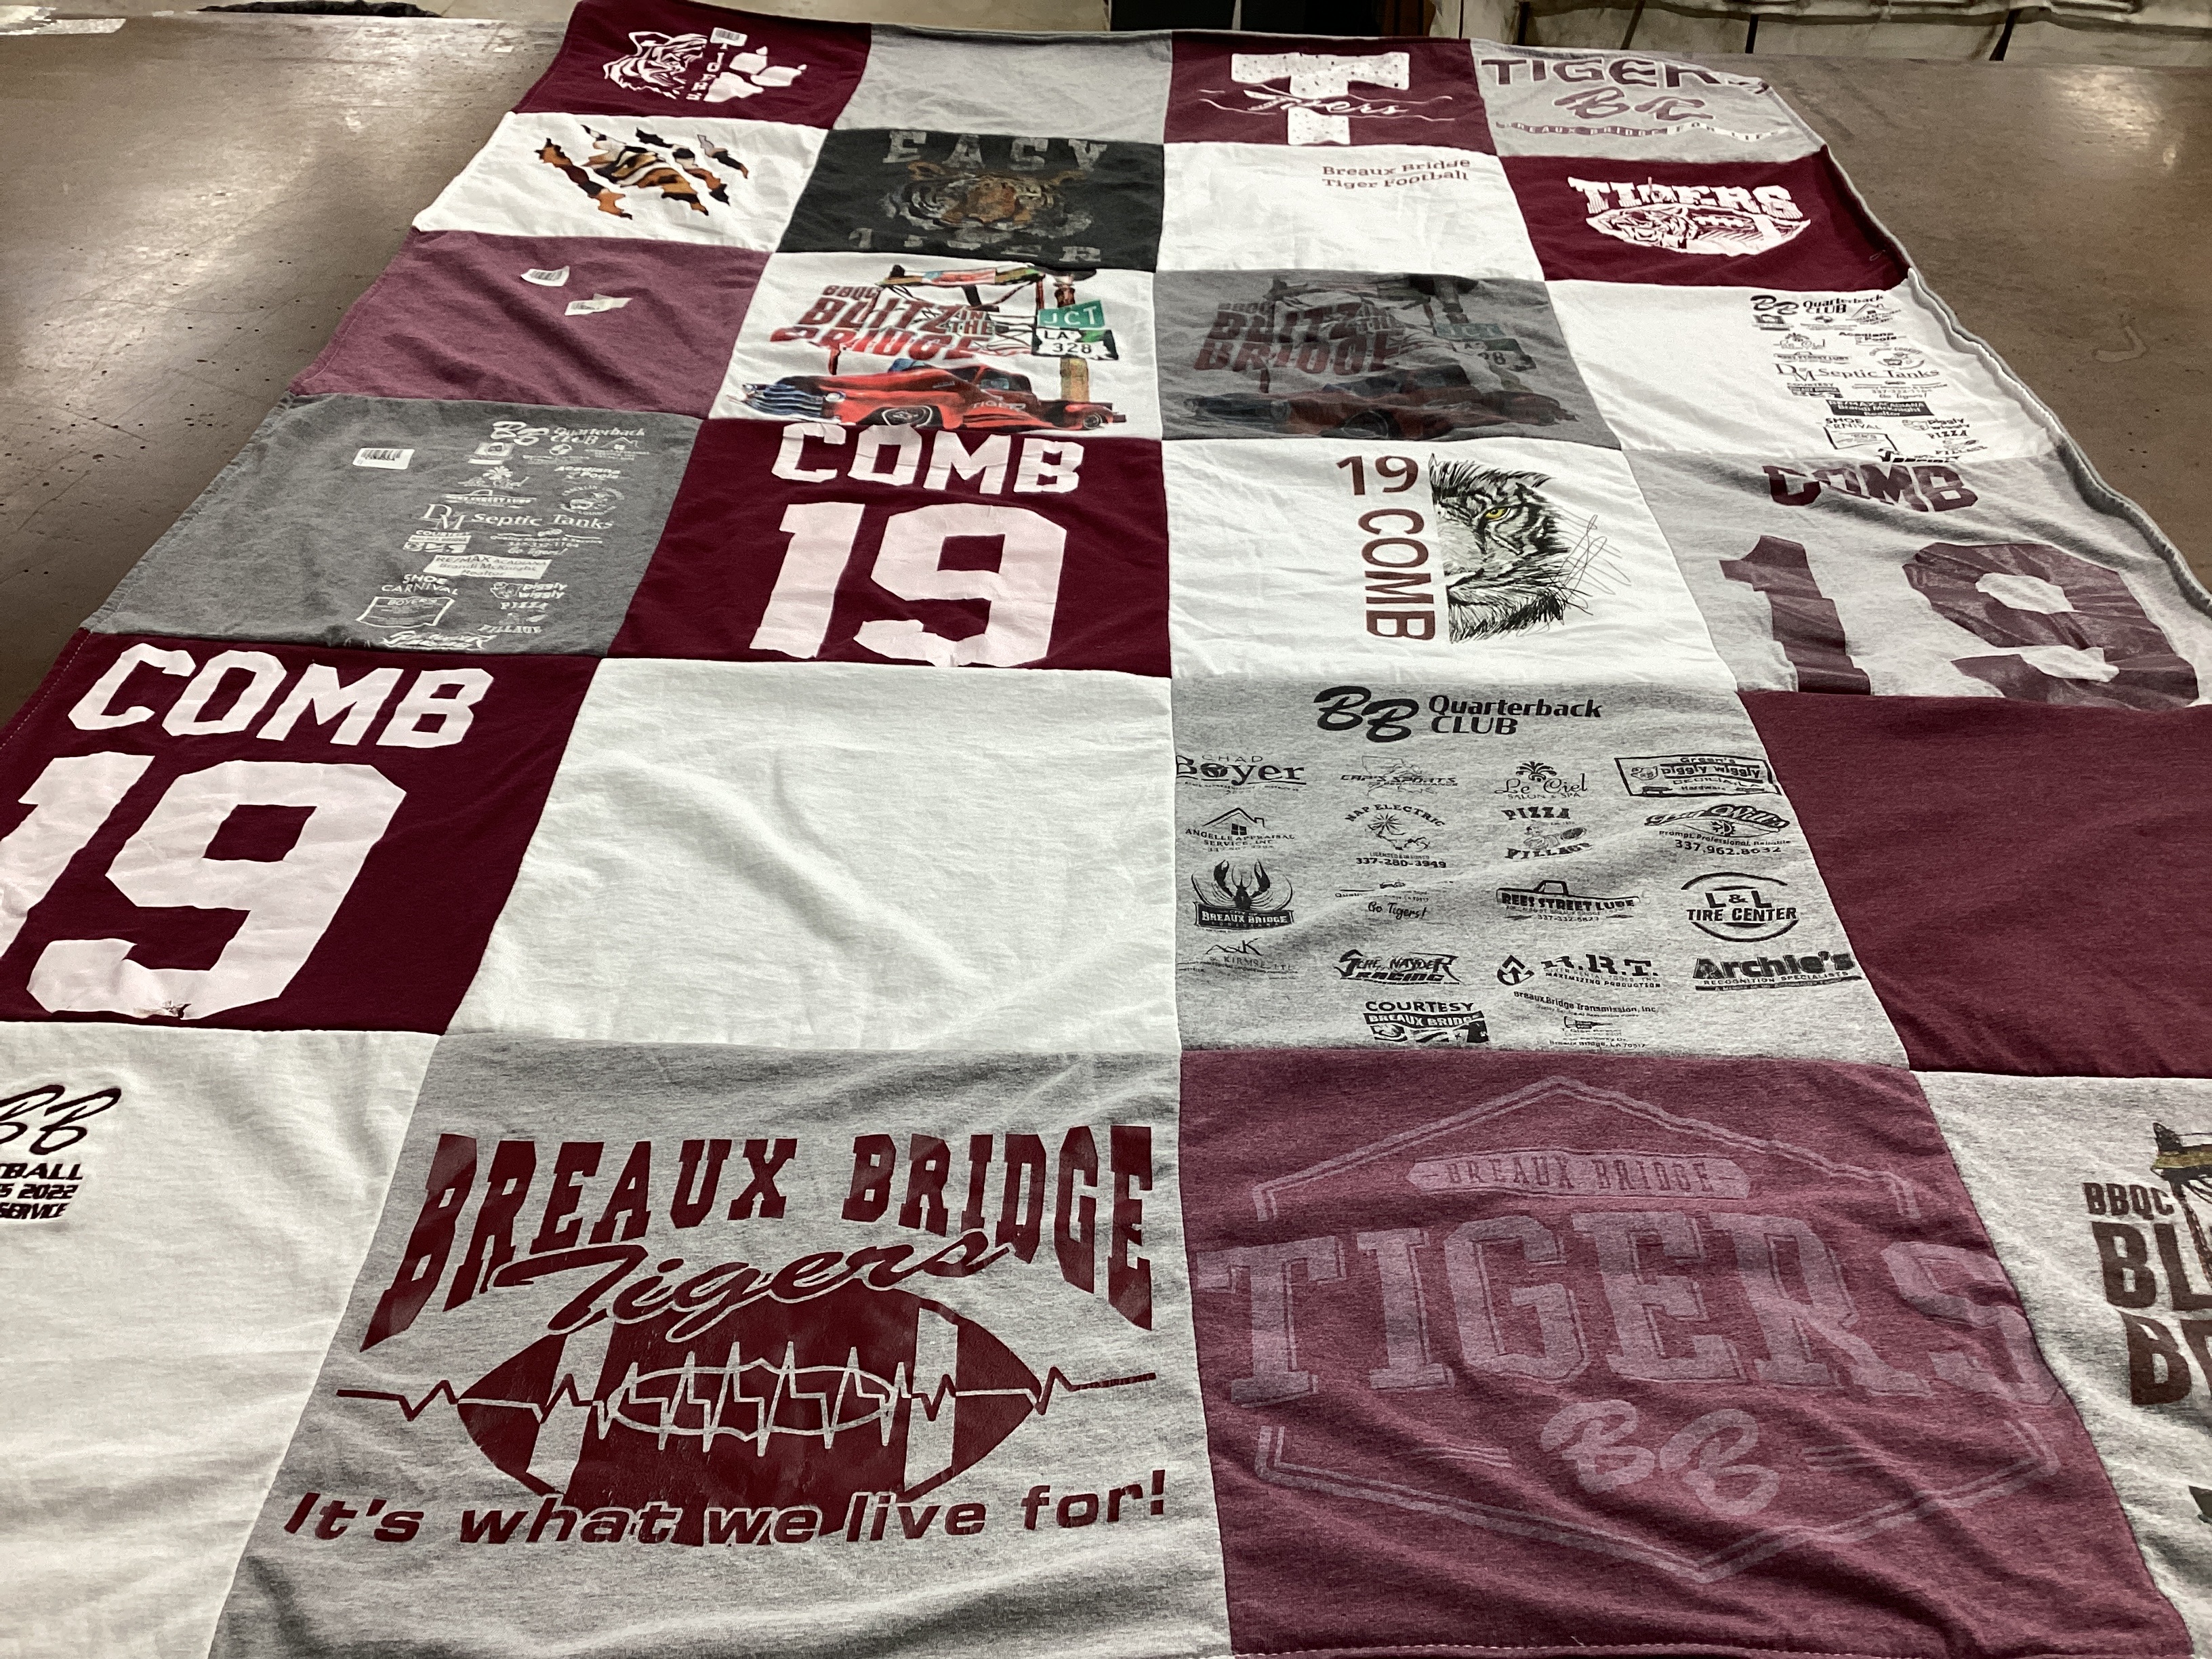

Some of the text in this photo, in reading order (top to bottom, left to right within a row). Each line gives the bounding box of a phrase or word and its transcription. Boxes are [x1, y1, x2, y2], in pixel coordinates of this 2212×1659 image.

[1322, 165, 1396, 178] Breaux
[1044, 305, 1098, 325] JCT
[1052, 342, 1092, 354] 328
[1818, 368, 1877, 380] Septic
[1884, 369, 1940, 379] Tanks
[554, 427, 644, 436] Quarterback
[772, 422, 1084, 495] COMB
[1336, 455, 1419, 495] 19
[471, 513, 544, 526] Septic
[553, 514, 614, 529] Tanks
[403, 574, 447, 585] SHOE
[1357, 508, 1436, 641] COMB
[381, 583, 459, 595] CARNIVAL
[750, 501, 1067, 668] 19
[1719, 535, 2200, 711] 19
[68, 642, 495, 748] COMB
[1313, 685, 1420, 743] BB
[1429, 695, 1603, 718] Quarterback
[1431, 716, 1519, 735] CLUB
[1202, 754, 1263, 763] CHAD
[1176, 755, 1305, 786] Boyer
[1660, 764, 1761, 779] piggly wiggly
[1494, 773, 1588, 794] Le Ciel
[1373, 804, 1446, 827] ELECTRIC
[1501, 806, 1571, 821] PIZZA
[0, 751, 407, 1021] 19
[1538, 898, 1593, 912] STREET
[1705, 890, 1772, 909] L & L
[1202, 911, 1288, 924] BREAUX BRIDGE
[1368, 901, 1427, 920] Go Tigers!
[1686, 907, 1797, 922] TIRE CENTER
[1693, 951, 1856, 979] Archie's
[1545, 972, 1601, 985] MAXIMIZING
[1781, 971, 1849, 981] SPECIALISTS
[1365, 1001, 1474, 1012] COURTESY
[1514, 991, 1544, 1003] Breaux
[1546, 995, 1574, 1010] Bridge
[1369, 1014, 1424, 1026] BREAUX
[1445, 1155, 1715, 1193] BREAUX BRIDGE
[17, 1183, 79, 1200] 2022
[2082, 1182, 2175, 1221] BBQC
[360, 1125, 1154, 1354] BREAUX BRIDGE
[491, 1227, 1013, 1342] Tigers
[1197, 1212, 2060, 1408] TIGERS
[284, 1469, 1166, 1545] It's what we live for!
